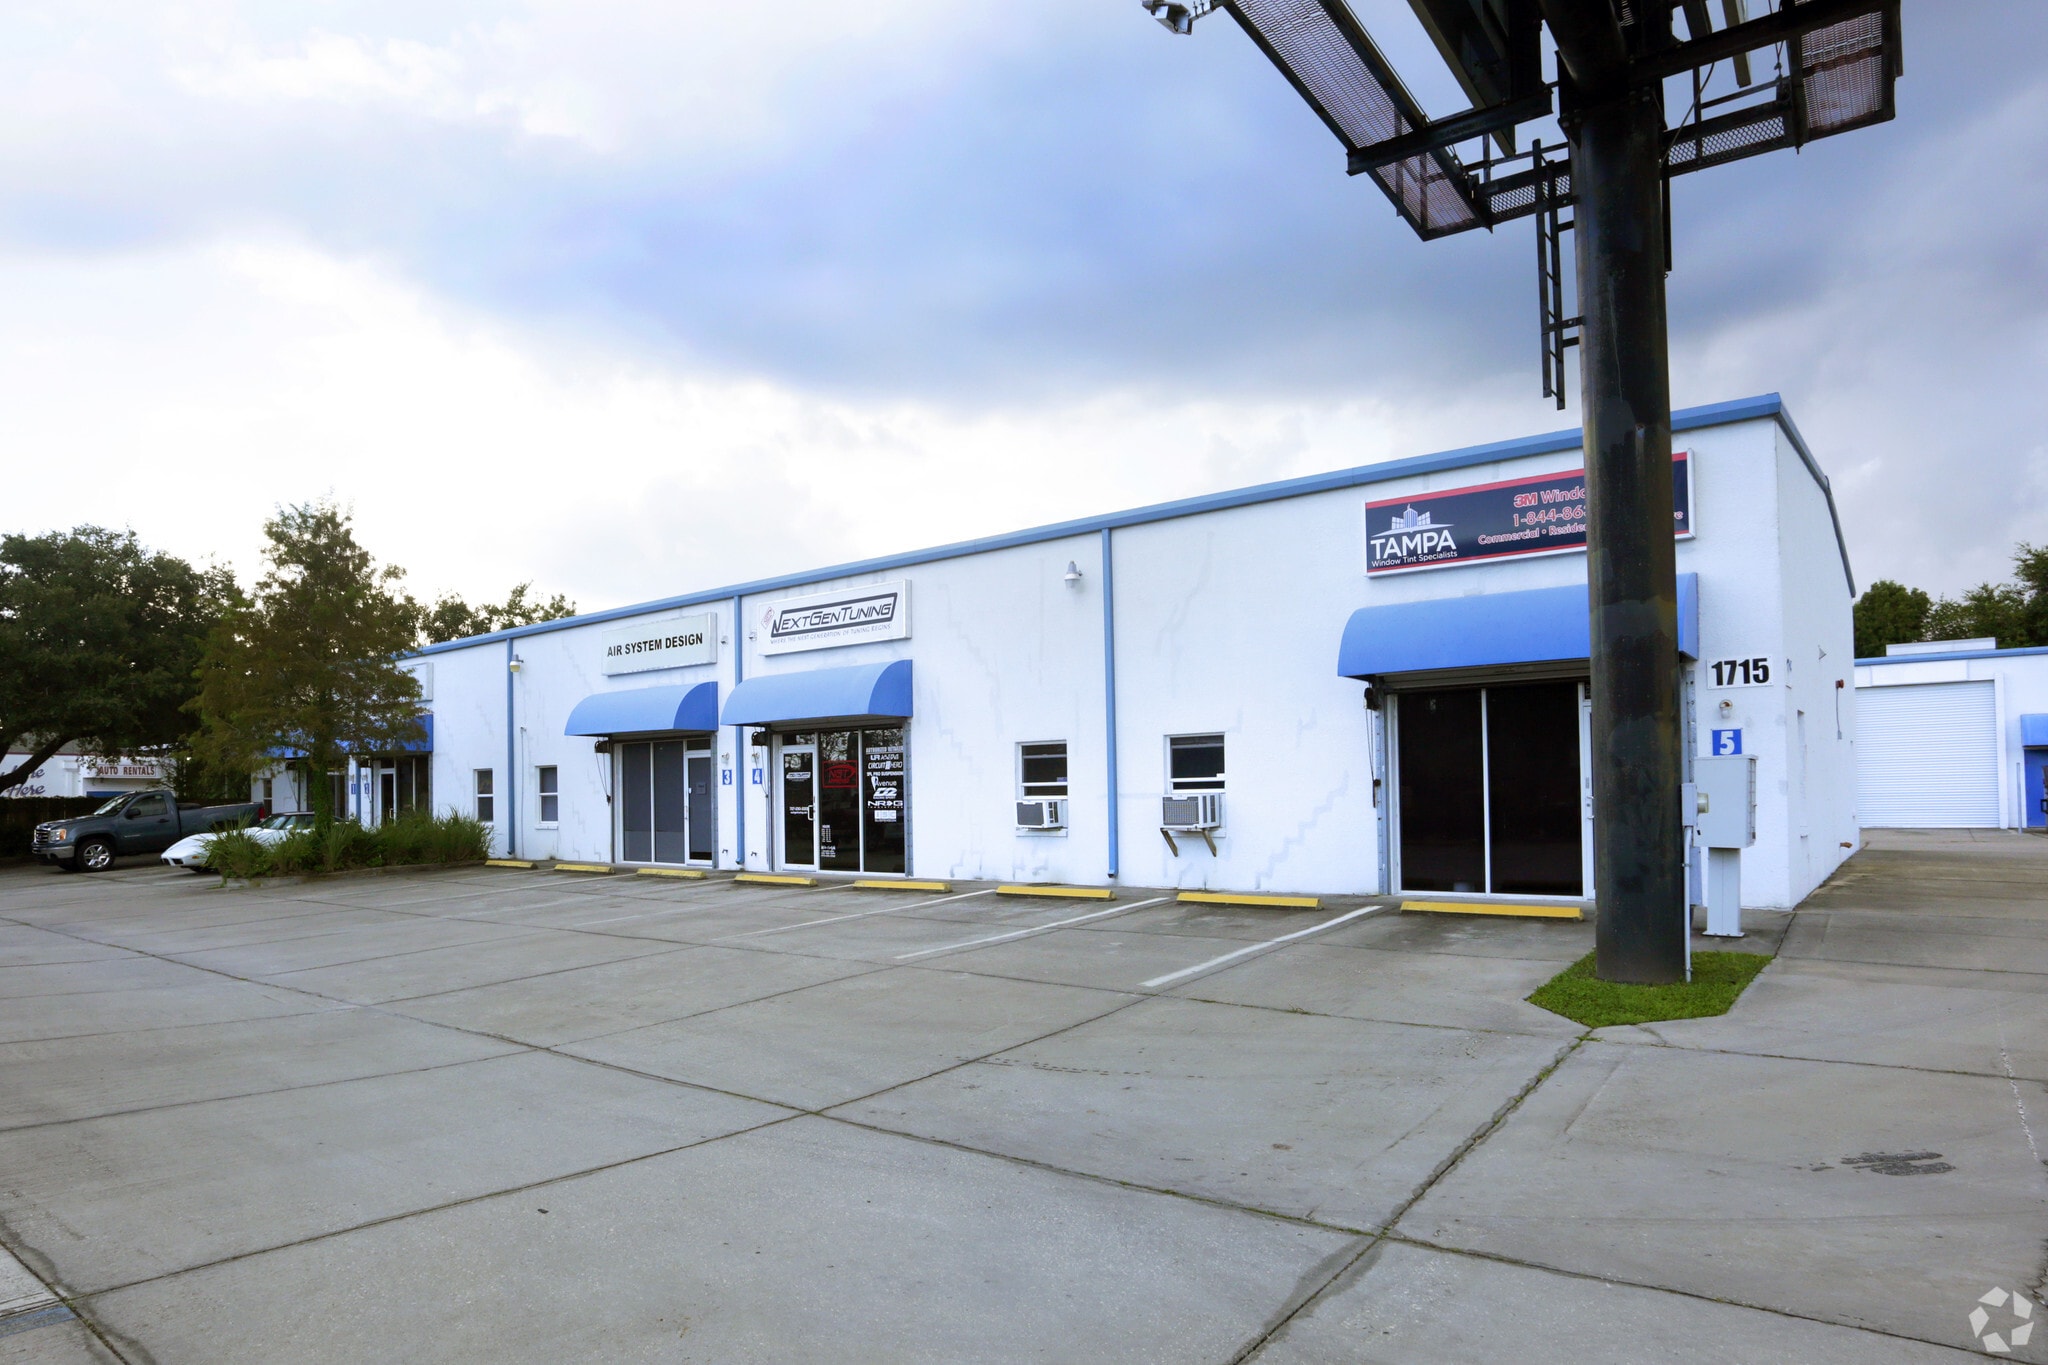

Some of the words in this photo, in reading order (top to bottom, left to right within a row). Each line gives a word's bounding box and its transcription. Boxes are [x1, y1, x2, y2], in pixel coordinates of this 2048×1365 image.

[1513, 491, 1538, 508] 3M
[1540, 485, 1586, 504] Windo
[1513, 504, 1586, 527] 1-844-86
[1370, 529, 1457, 560] TAMPA
[1477, 527, 1540, 545] Commercial
[1548, 522, 1587, 536] Reside
[1371, 558, 1401, 567] Window
[1403, 555, 1417, 563] Tint
[1418, 550, 1458, 562] Specialists
[607, 645, 622, 657] AIR
[625, 639, 662, 655] SYSTEM
[665, 632, 703, 649] DESIGN
[1711, 657, 1770, 686] 1715
[1719, 731, 1735, 755] 5
[98, 766, 118, 775] AUTO
[123, 766, 155, 776] RENTALS
[724, 770, 731, 785] 3
[754, 769, 760, 784] 4
